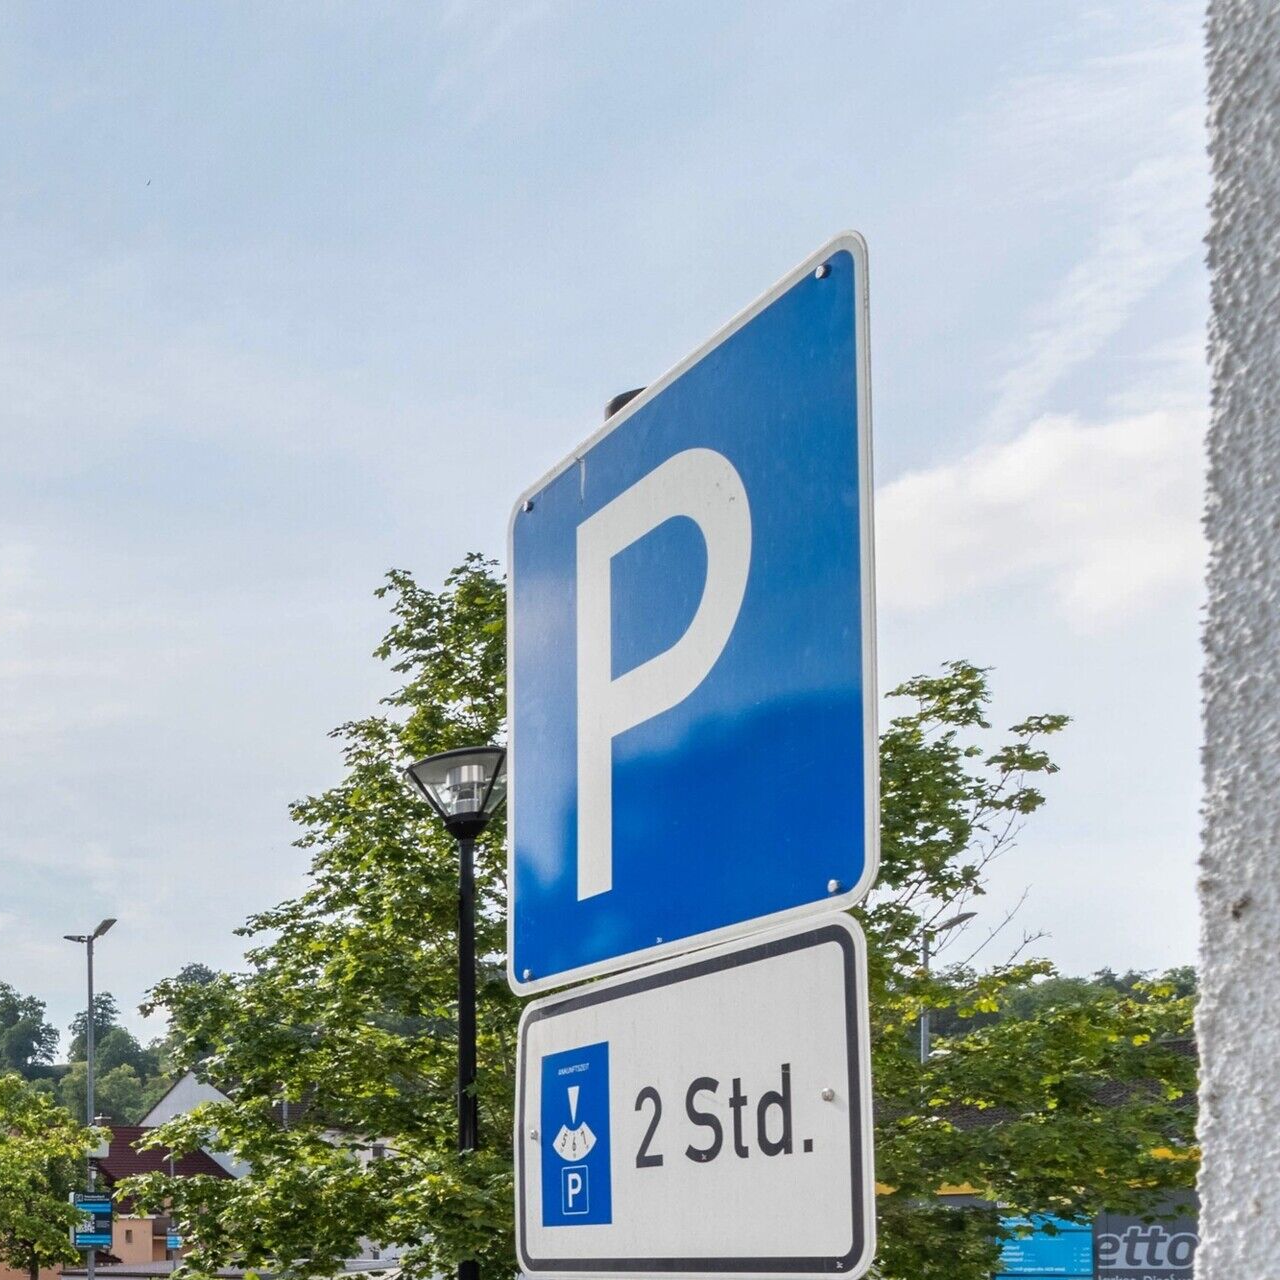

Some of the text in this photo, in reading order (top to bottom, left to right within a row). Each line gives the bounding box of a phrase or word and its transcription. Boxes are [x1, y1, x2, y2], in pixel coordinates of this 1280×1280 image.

[576, 447, 753, 902] P
[634, 1062, 814, 1169] 2 Std.
[567, 1172, 583, 1208] P
[1097, 1226, 1200, 1269] etto
